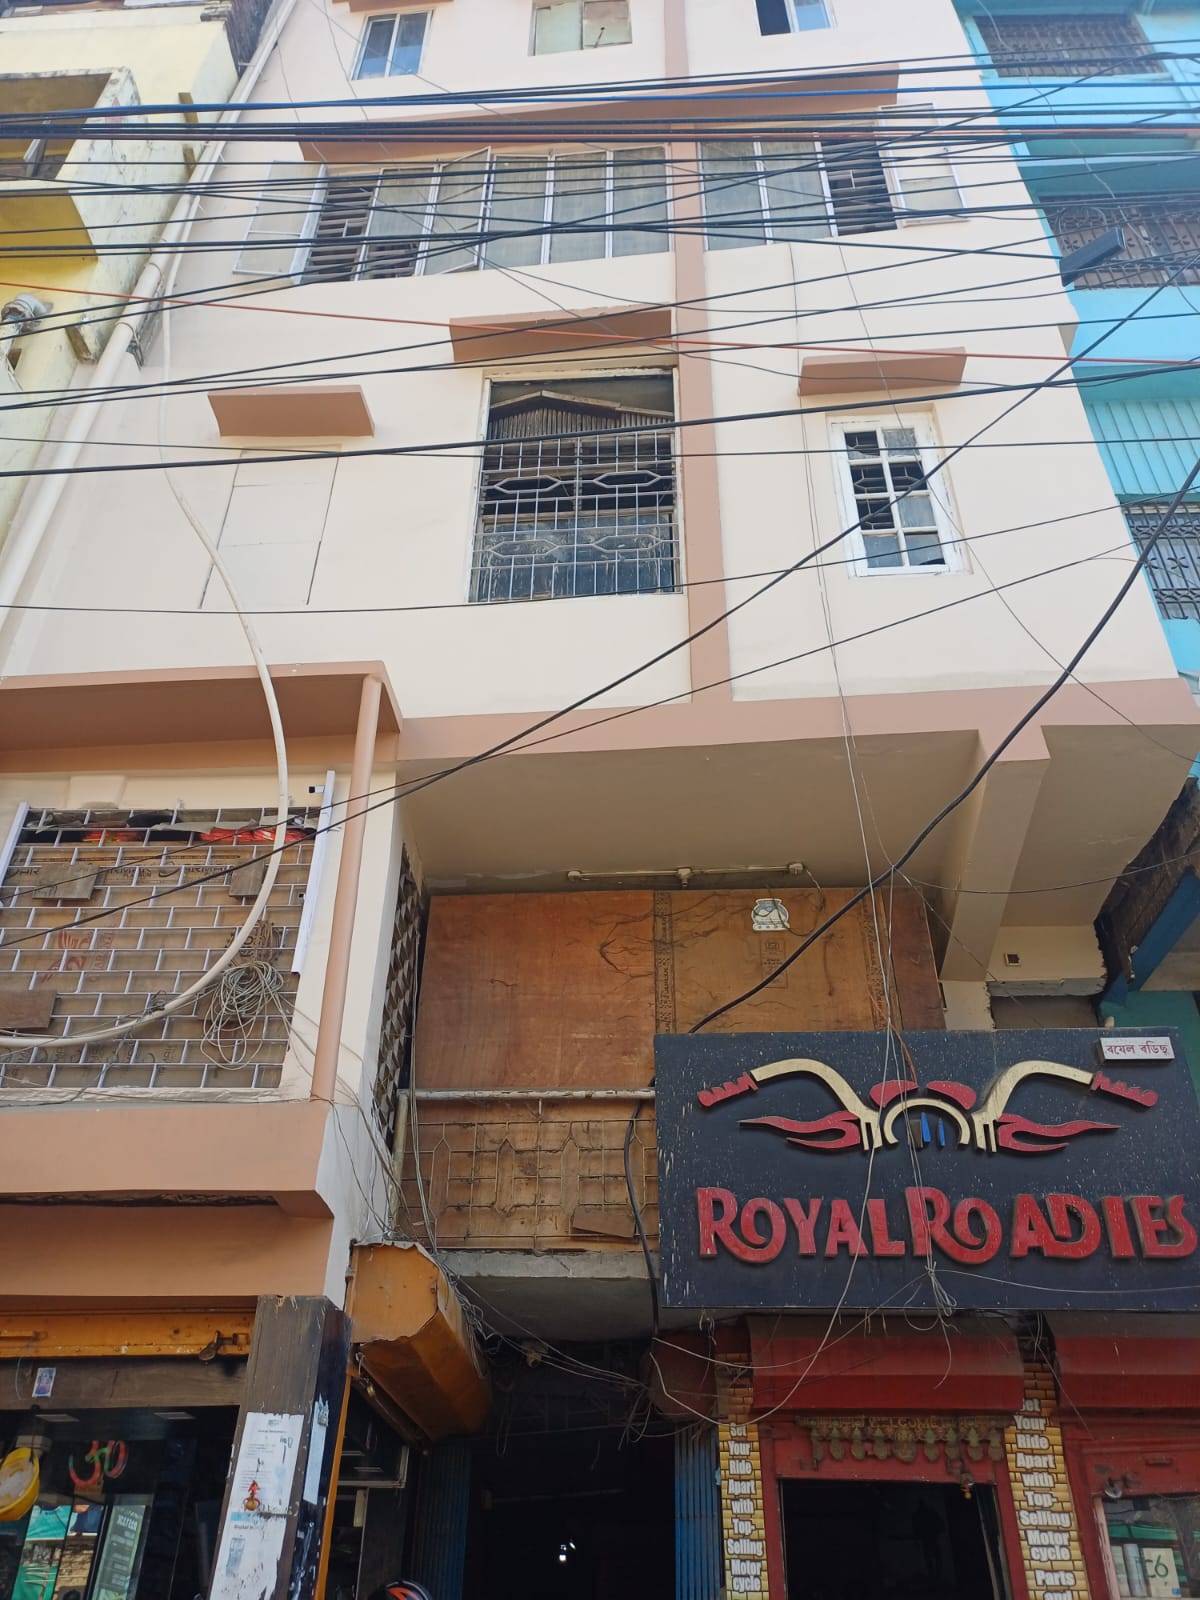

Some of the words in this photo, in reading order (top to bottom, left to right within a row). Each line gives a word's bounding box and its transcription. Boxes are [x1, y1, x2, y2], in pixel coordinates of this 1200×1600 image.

[696, 1186, 905, 1263] ROYAL
[905, 1186, 1199, 1264] ROADIES
[1013, 1415, 1046, 1431] Your
[728, 1440, 751, 1456] Your
[1016, 1433, 1050, 1450] Ride
[729, 1459, 752, 1475] Ride
[1016, 1452, 1056, 1469] Apart
[728, 1478, 756, 1496] Apart
[1021, 1472, 1055, 1488] with
[731, 1498, 754, 1515] with
[1019, 1510, 1072, 1528] Selling
[1026, 1530, 1069, 1546] Motor
[727, 1538, 763, 1556] Selling
[1030, 1545, 1071, 1562] cycle
[730, 1559, 761, 1576] Motor
[732, 1575, 761, 1593] cycle
[1034, 1569, 1076, 1586] Parts
